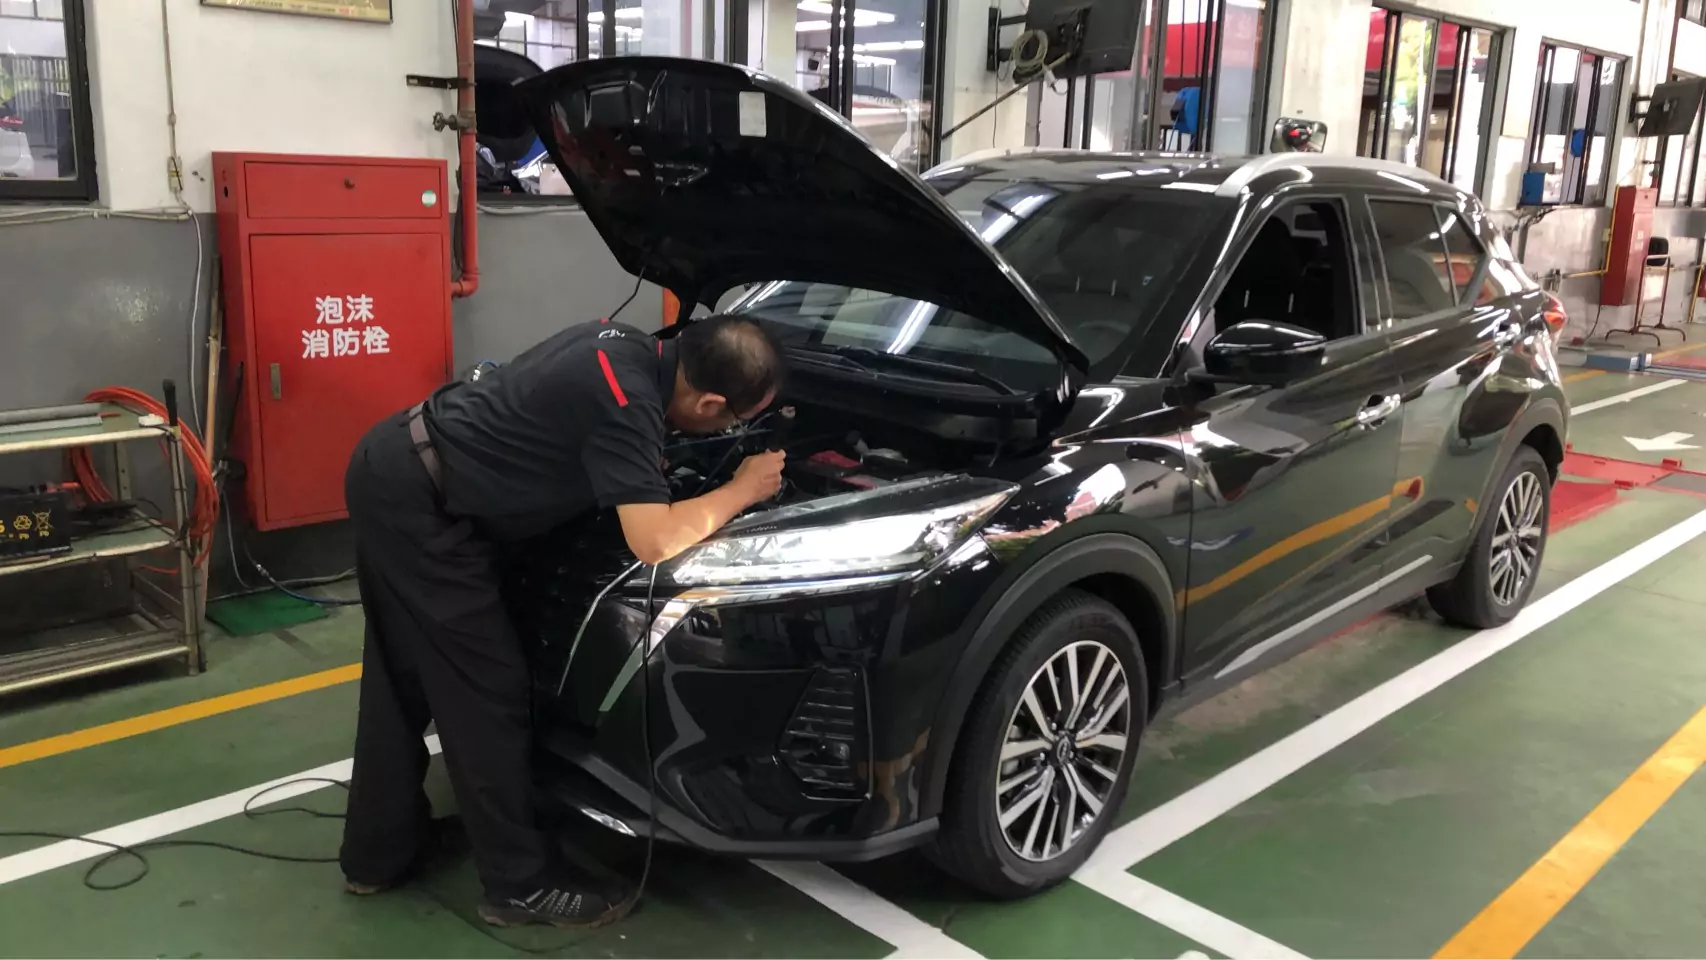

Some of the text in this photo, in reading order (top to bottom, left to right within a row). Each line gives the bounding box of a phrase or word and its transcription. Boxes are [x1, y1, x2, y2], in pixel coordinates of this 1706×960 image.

[315, 293, 374, 324] 泡沫
[301, 326, 390, 359] 消防栓
